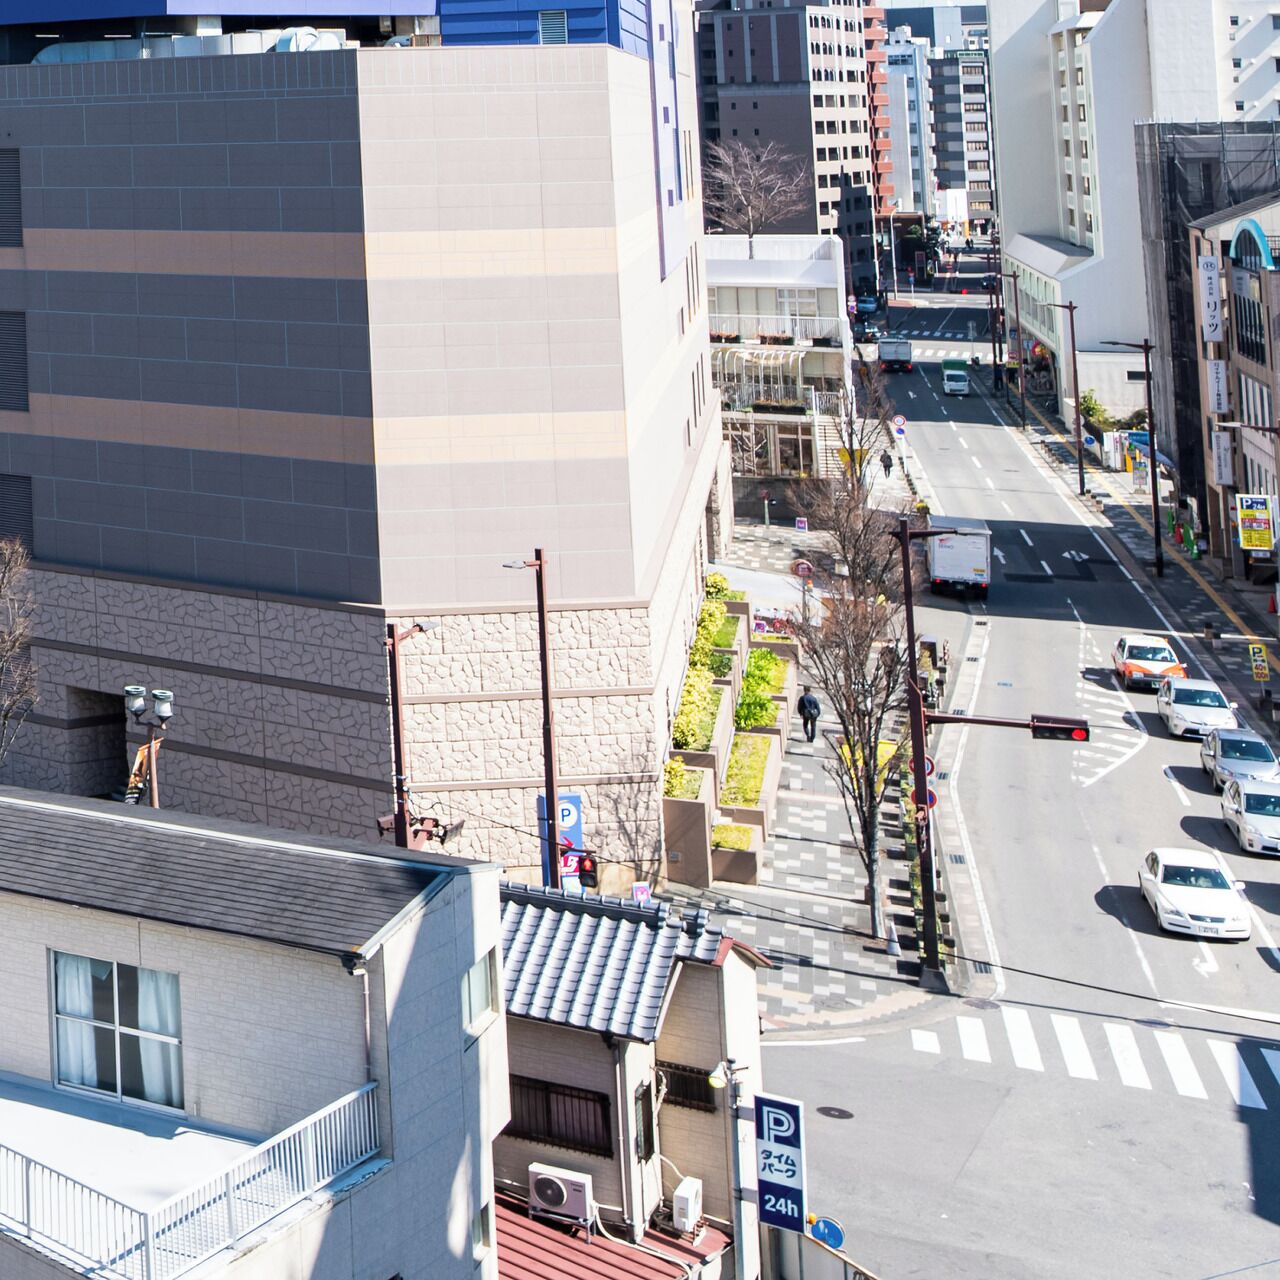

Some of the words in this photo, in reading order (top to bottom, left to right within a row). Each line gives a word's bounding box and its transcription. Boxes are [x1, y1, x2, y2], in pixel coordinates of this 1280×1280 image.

[1207, 300, 1219, 334] リッツ
[1242, 497, 1252, 509] P
[1252, 647, 1263, 658] P
[561, 808, 572, 822] P
[762, 1105, 795, 1145] P
[760, 1149, 797, 1168] タイム
[761, 1162, 797, 1179] パーク
[763, 1193, 799, 1218] 24h
